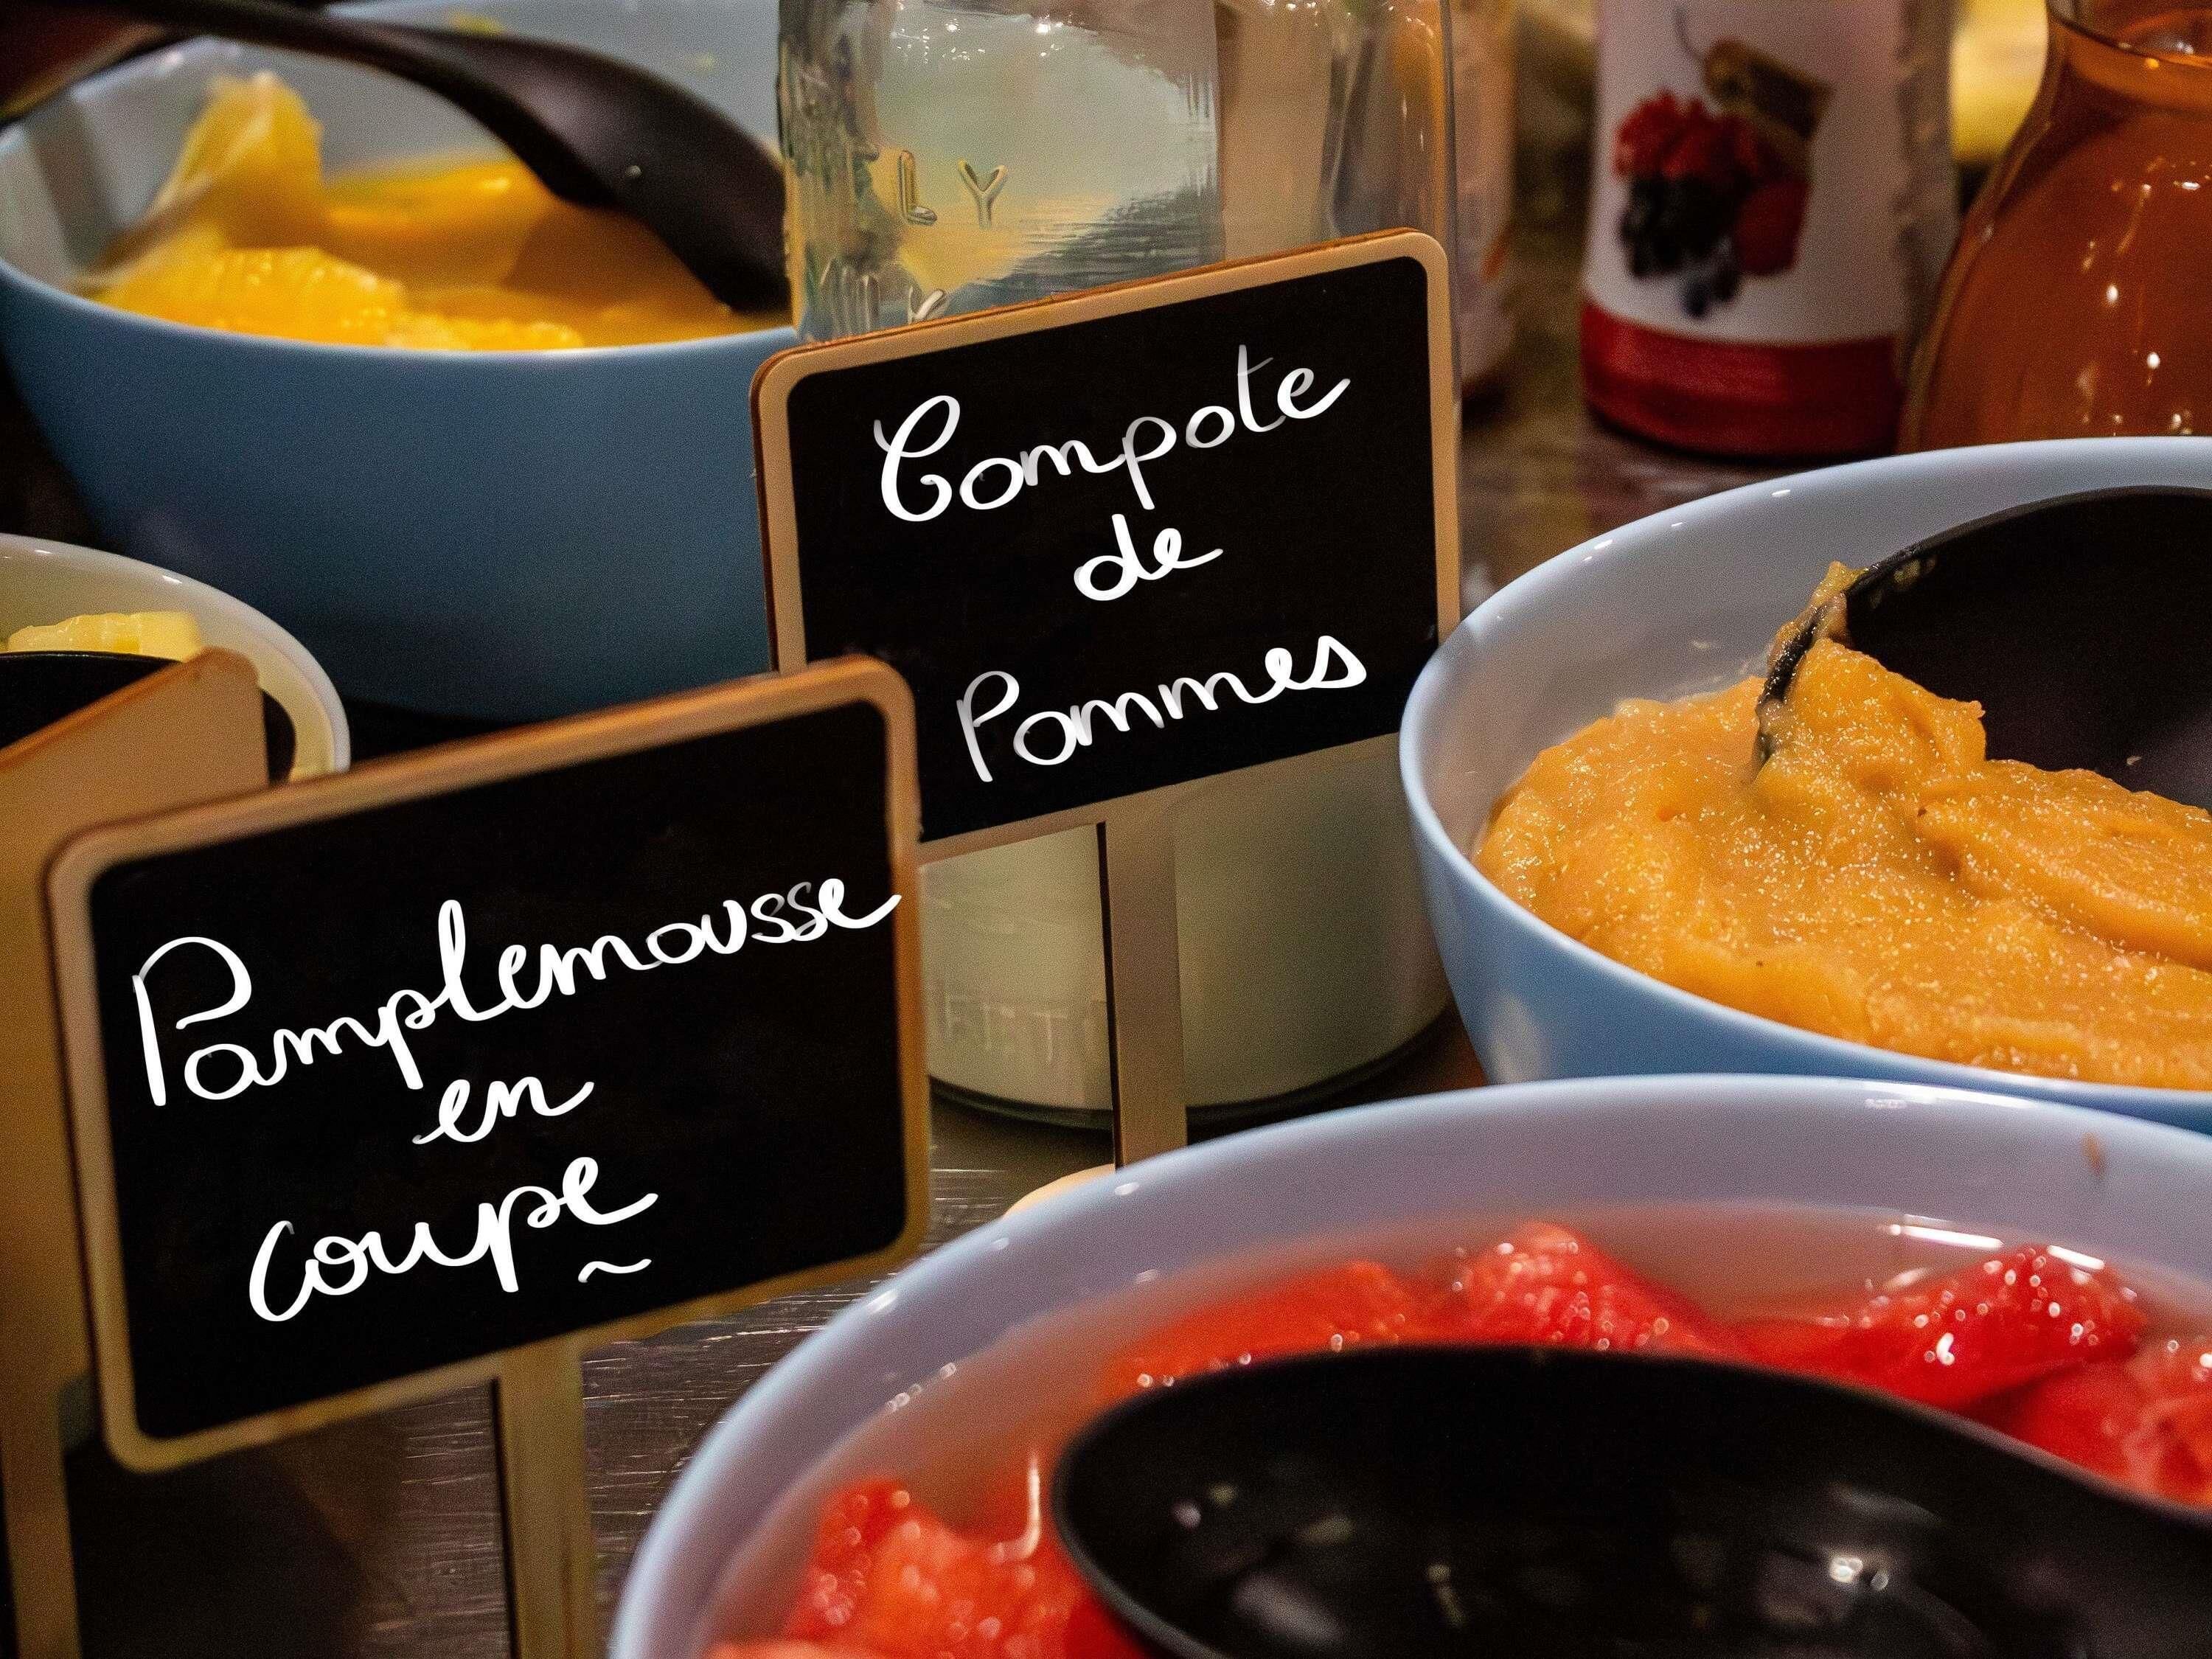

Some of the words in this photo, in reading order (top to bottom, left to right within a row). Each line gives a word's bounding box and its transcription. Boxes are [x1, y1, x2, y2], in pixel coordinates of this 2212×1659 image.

[873, 344, 1351, 522] Compote
[1074, 513, 1223, 602] de
[956, 635, 1367, 782] Pommes
[132, 877, 903, 1107] Pamplemousse
[412, 1076, 595, 1145] en
[248, 1156, 658, 1322] coupe
